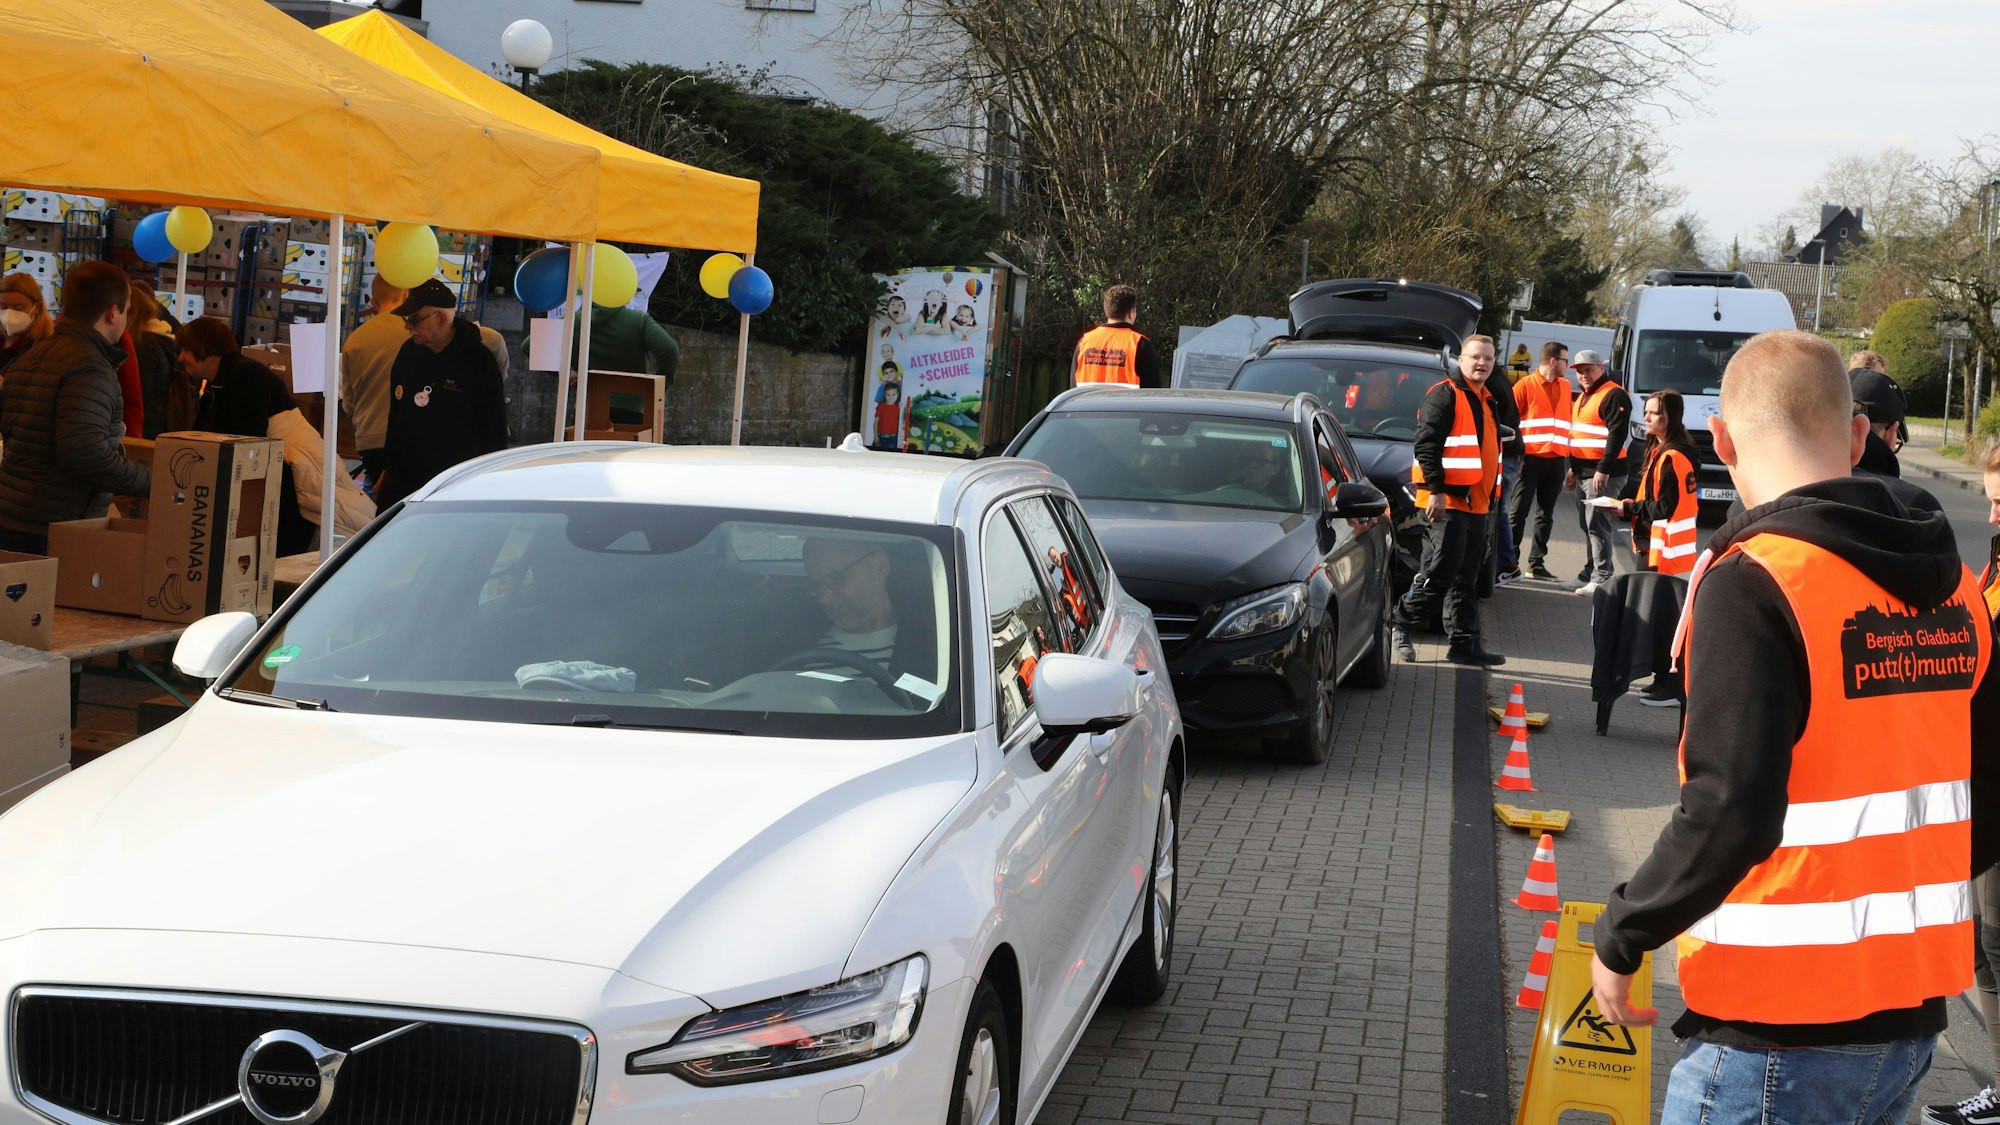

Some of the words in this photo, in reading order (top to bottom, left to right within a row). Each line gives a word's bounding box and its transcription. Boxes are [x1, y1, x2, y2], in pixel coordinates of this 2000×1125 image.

[910, 347, 974, 368] ALTKLEIDER
[919, 363, 971, 381] +SCHUHE
[187, 485, 209, 583] BANANAS
[1866, 630, 1913, 653] Bergisch
[1916, 626, 1970, 646] Gladbach
[1855, 651, 1976, 689] putz(t)munter
[251, 1073, 316, 1087] VOLVO
